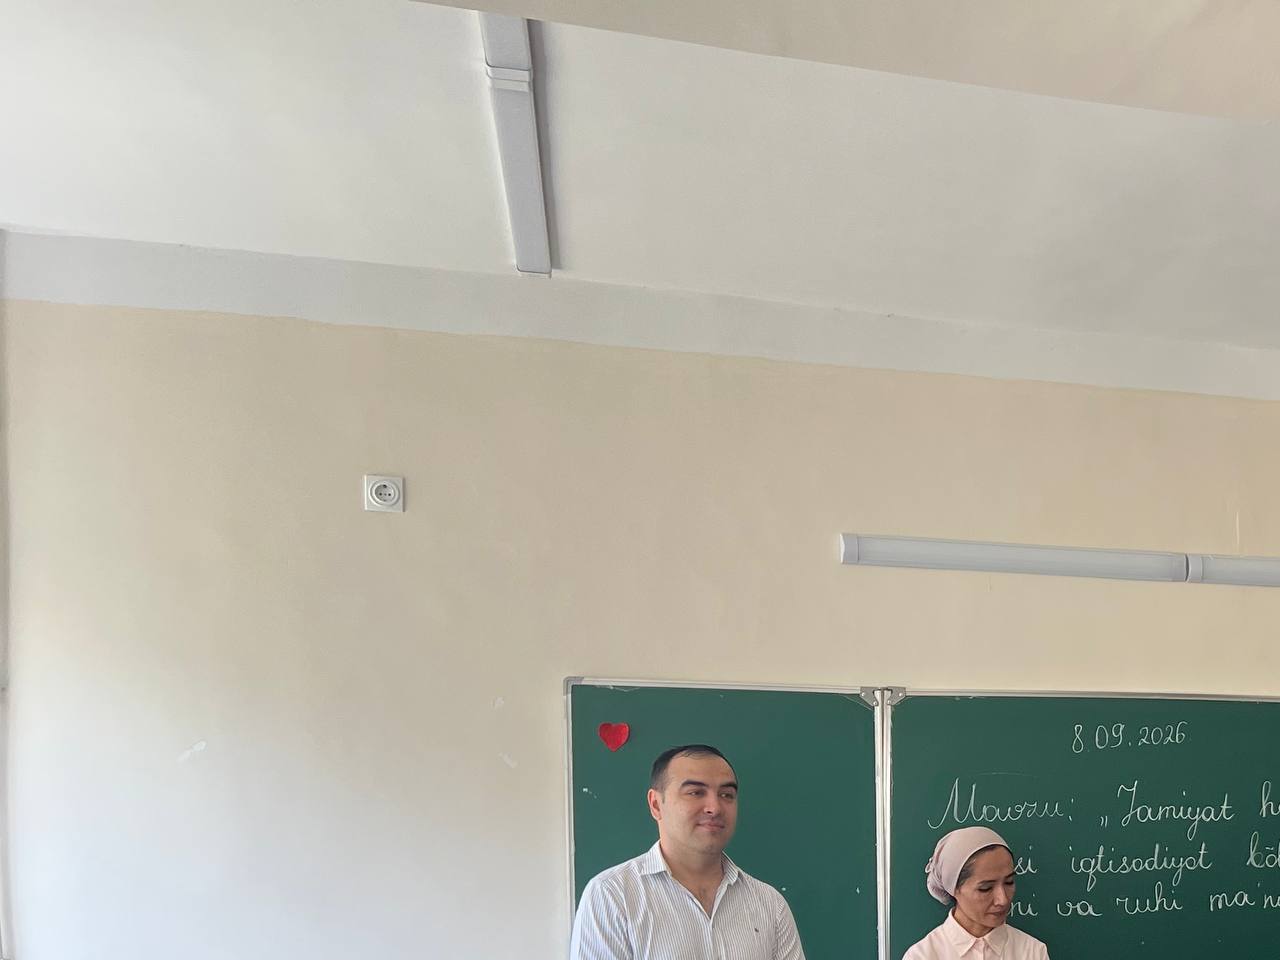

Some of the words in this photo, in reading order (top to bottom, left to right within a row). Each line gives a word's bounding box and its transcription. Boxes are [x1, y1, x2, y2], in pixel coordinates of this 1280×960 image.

[927, 777, 1074, 829] Mavzu:
[1068, 842, 1212, 892] iqtisodiyot
[1056, 901, 1103, 917] va
[1116, 881, 1183, 915] ruhi
